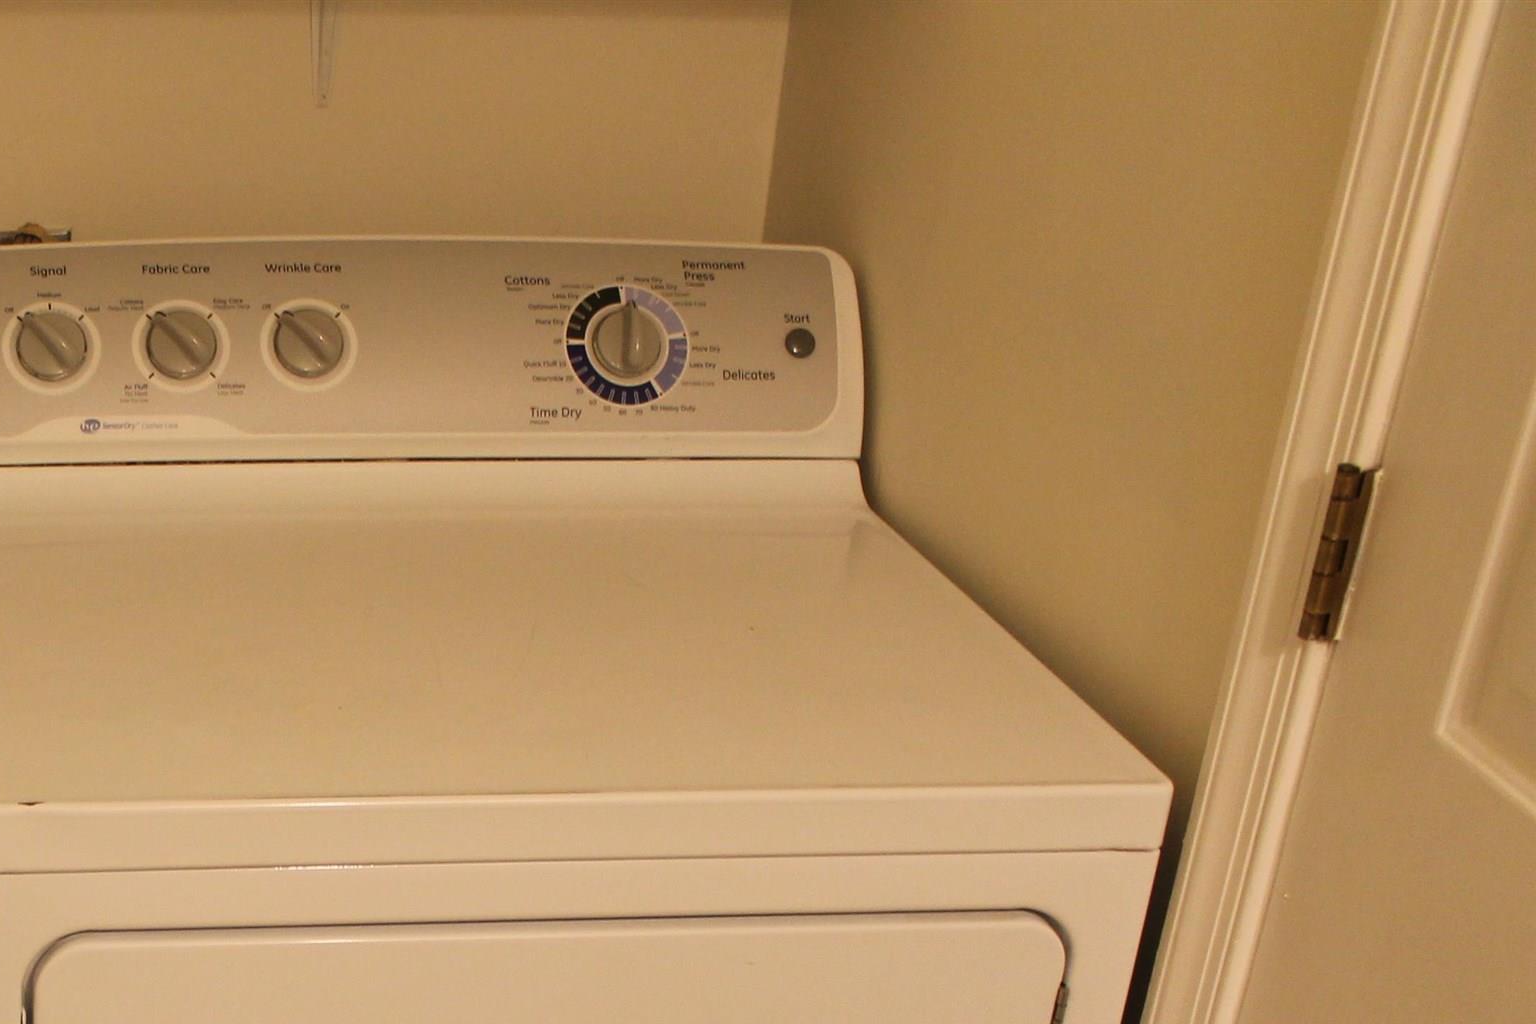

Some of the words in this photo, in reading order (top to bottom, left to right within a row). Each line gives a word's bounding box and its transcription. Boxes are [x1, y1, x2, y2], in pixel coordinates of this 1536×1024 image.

[142, 264, 179, 275] Fabric
[182, 264, 210, 274] Care
[264, 263, 311, 273] Wrinkle
[314, 263, 342, 273] Care
[682, 260, 745, 270] Permanent
[29, 265, 67, 277] Signal
[684, 271, 715, 281] Press
[504, 275, 551, 286] Cottons
[783, 313, 811, 324] Start
[722, 369, 776, 381] Delicates
[530, 407, 559, 418] Time
[561, 407, 582, 421] Dry
